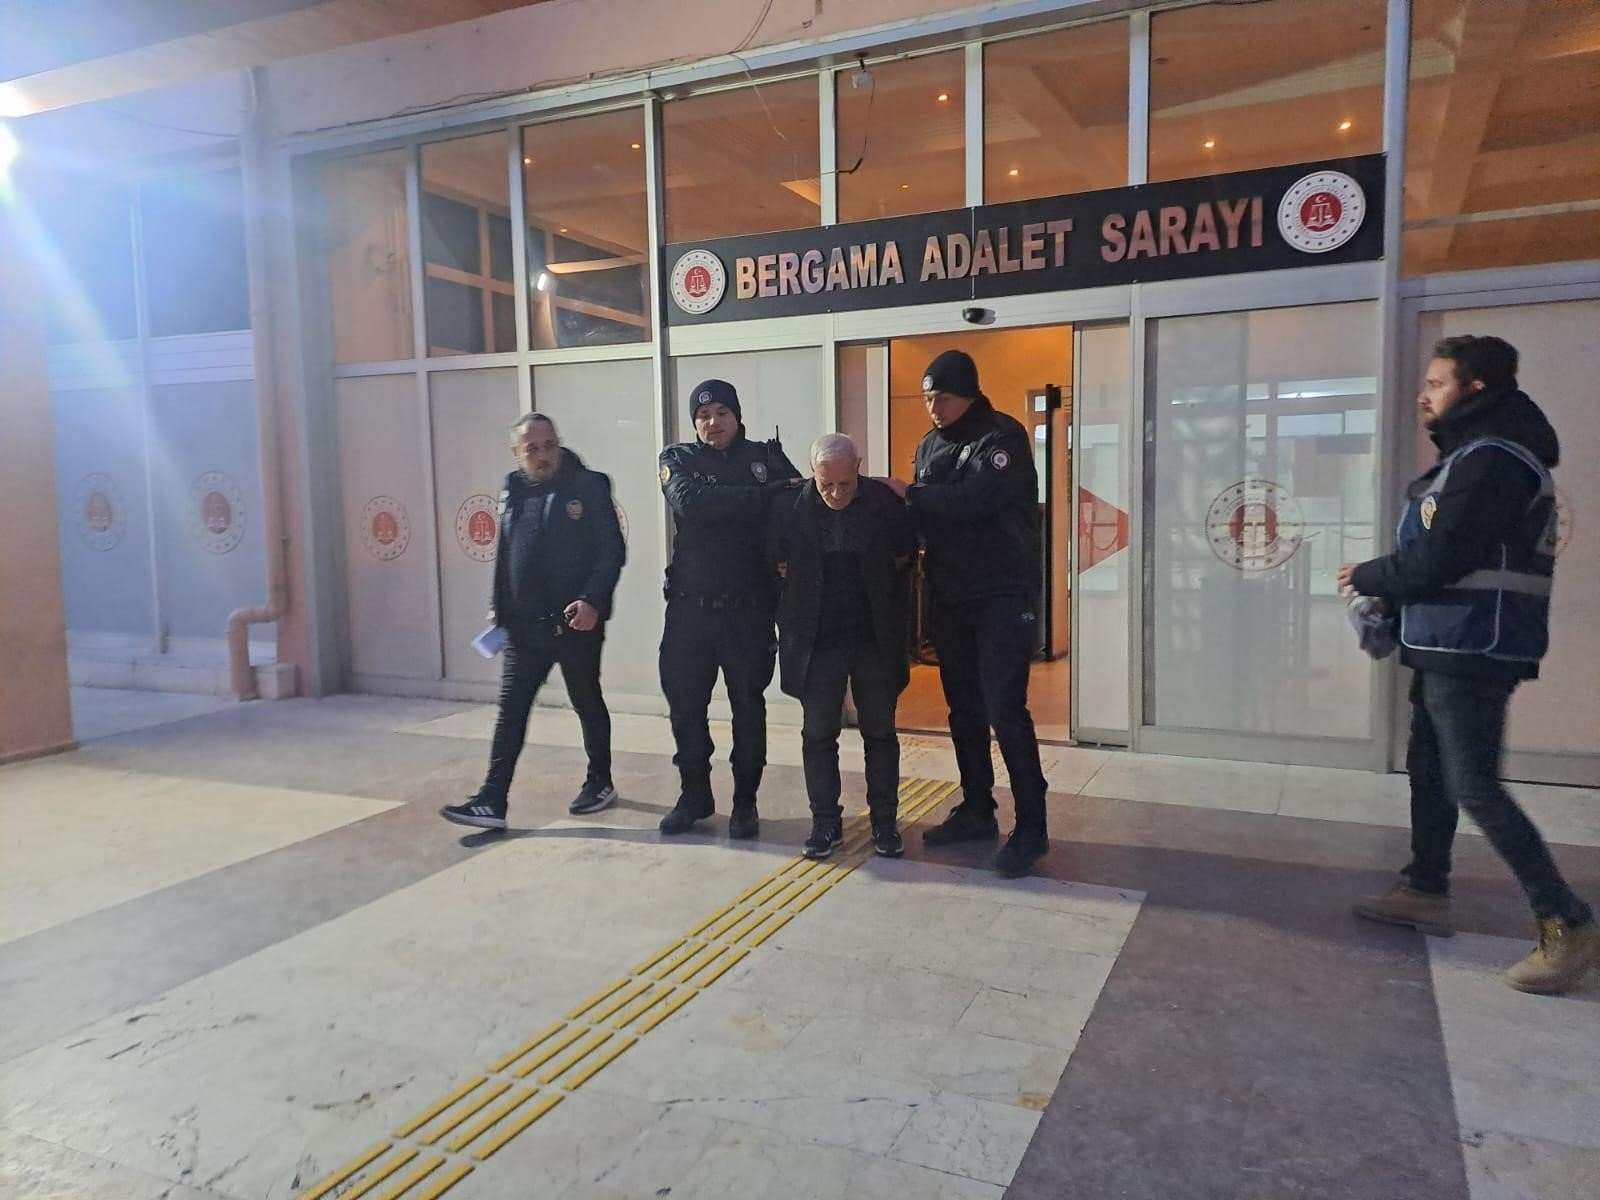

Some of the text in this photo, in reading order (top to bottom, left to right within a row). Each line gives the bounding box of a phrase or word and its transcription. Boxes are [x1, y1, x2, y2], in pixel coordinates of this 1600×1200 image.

[735, 240, 904, 299] BERGAMA
[920, 218, 1073, 282] ADALET
[1101, 197, 1263, 263] SARAYI
